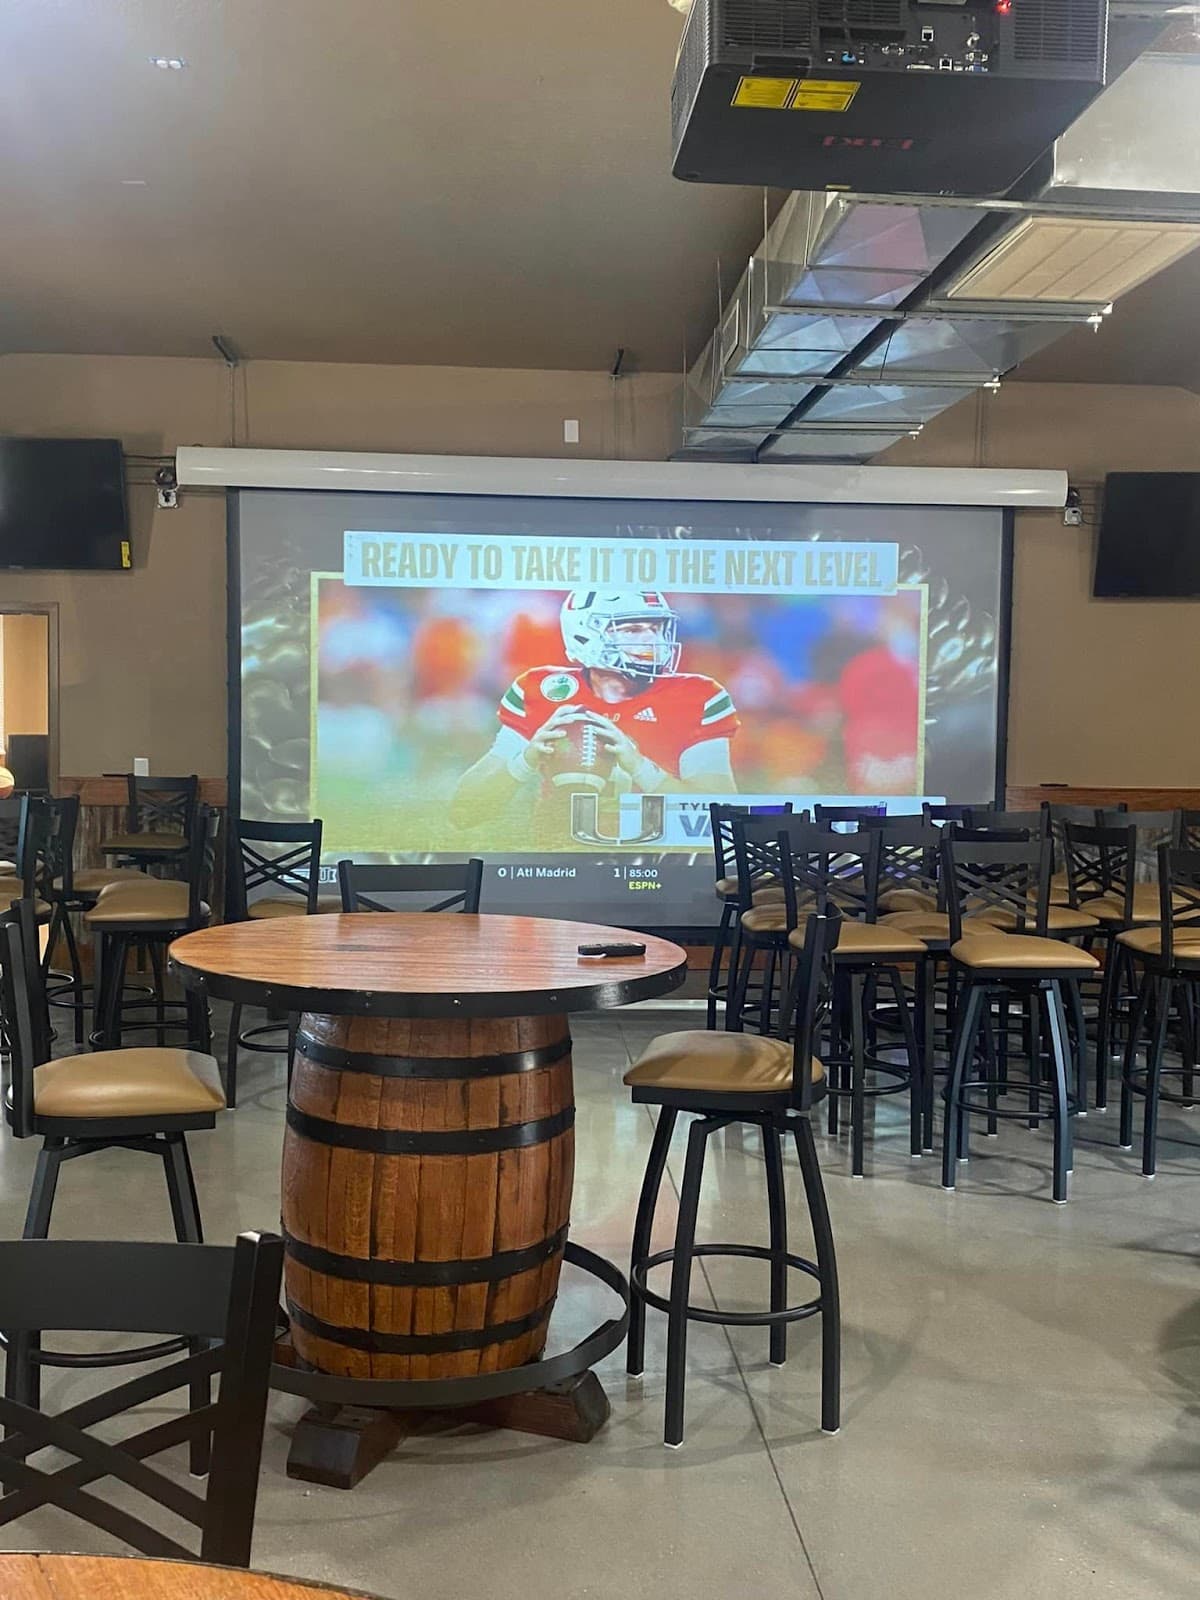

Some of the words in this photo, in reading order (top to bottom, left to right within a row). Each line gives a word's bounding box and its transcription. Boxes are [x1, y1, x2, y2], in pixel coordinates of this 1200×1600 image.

[361, 541, 459, 579] READY
[467, 544, 503, 580] TO
[511, 545, 582, 582] TAKE
[588, 547, 615, 583] IT
[621, 547, 657, 584] TO
[666, 549, 716, 585] THE
[724, 550, 798, 587] NEXT
[804, 551, 882, 588] LEVEL
[516, 867, 533, 878] Atl
[535, 867, 576, 878] Madrid
[613, 867, 621, 878] 1
[629, 869, 658, 878] 85:00
[628, 881, 662, 890] ESPN+
